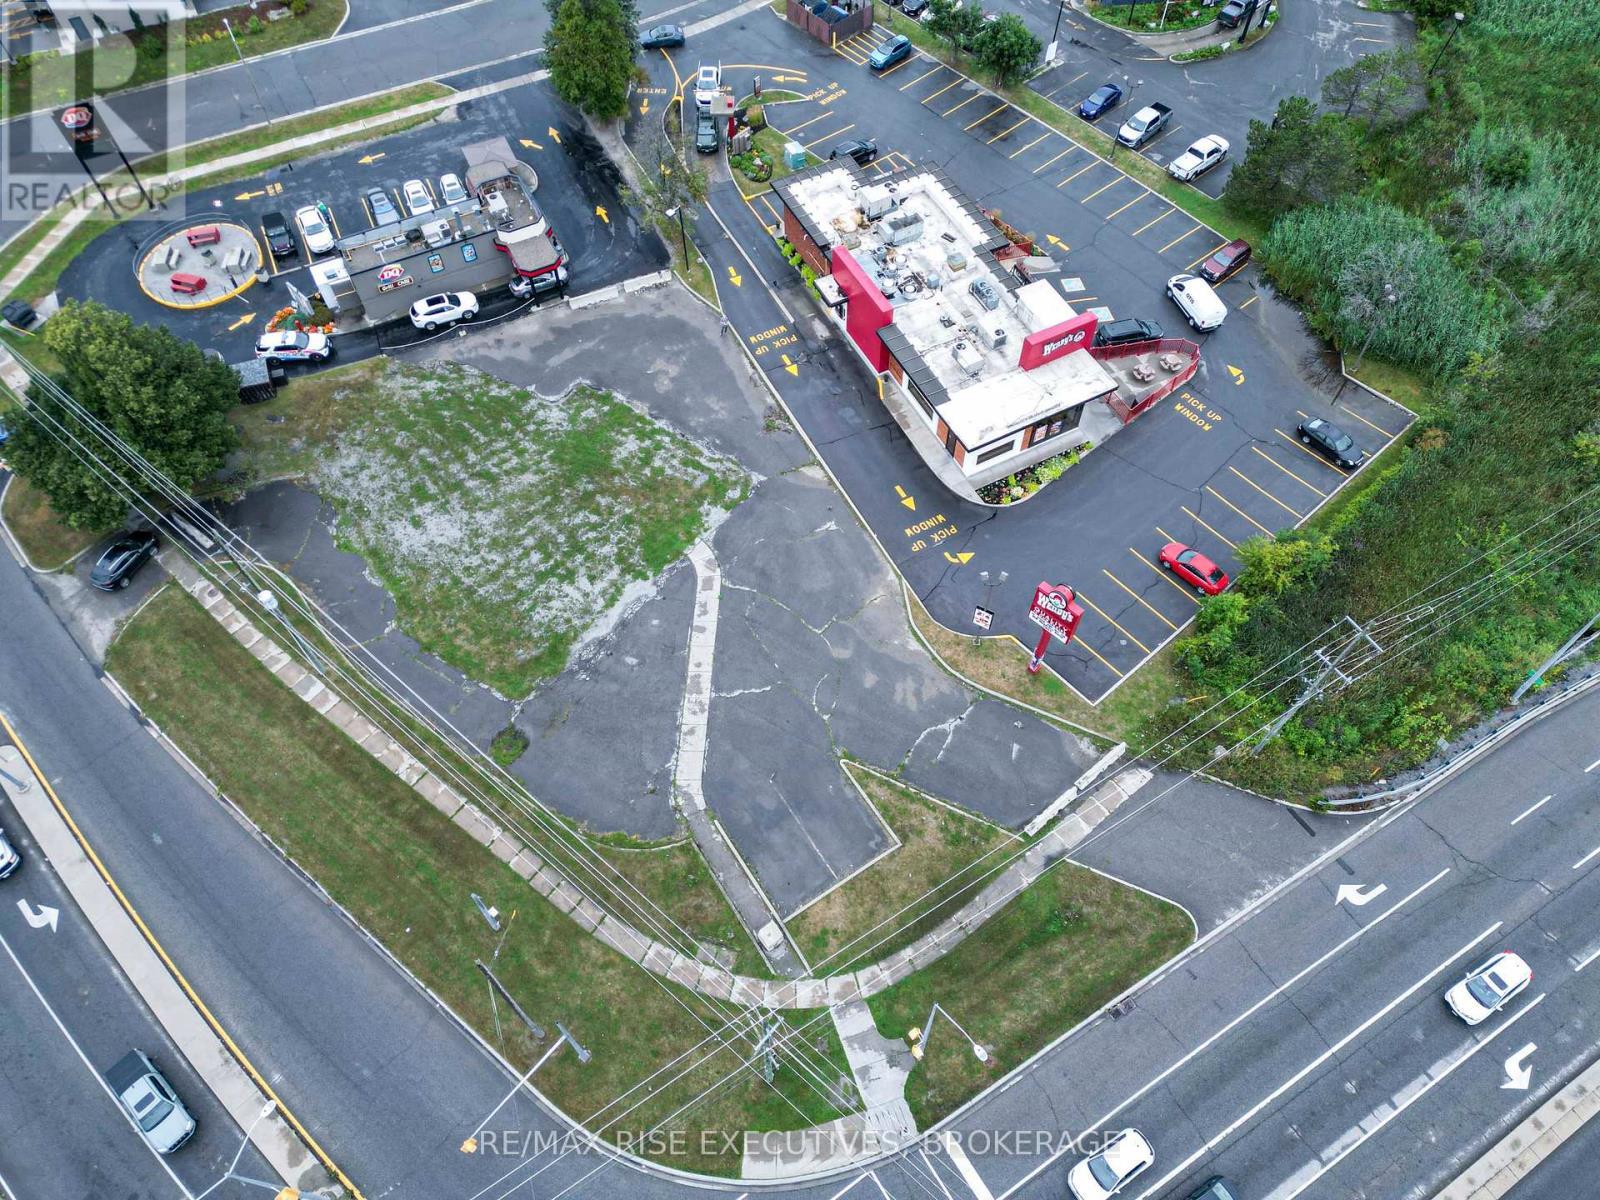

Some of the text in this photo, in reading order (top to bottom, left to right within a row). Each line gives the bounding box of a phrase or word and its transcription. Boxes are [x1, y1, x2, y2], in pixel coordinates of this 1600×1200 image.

[808, 81, 839, 100] PICK UP
[819, 89, 847, 105] WINDOW
[749, 325, 788, 344] WINDOW
[755, 334, 798, 355] PICK UP
[1174, 402, 1213, 431] WINDOW
[1180, 392, 1222, 421] PICK UP
[904, 513, 947, 537] WINDOW
[911, 524, 957, 552] PICK UP
